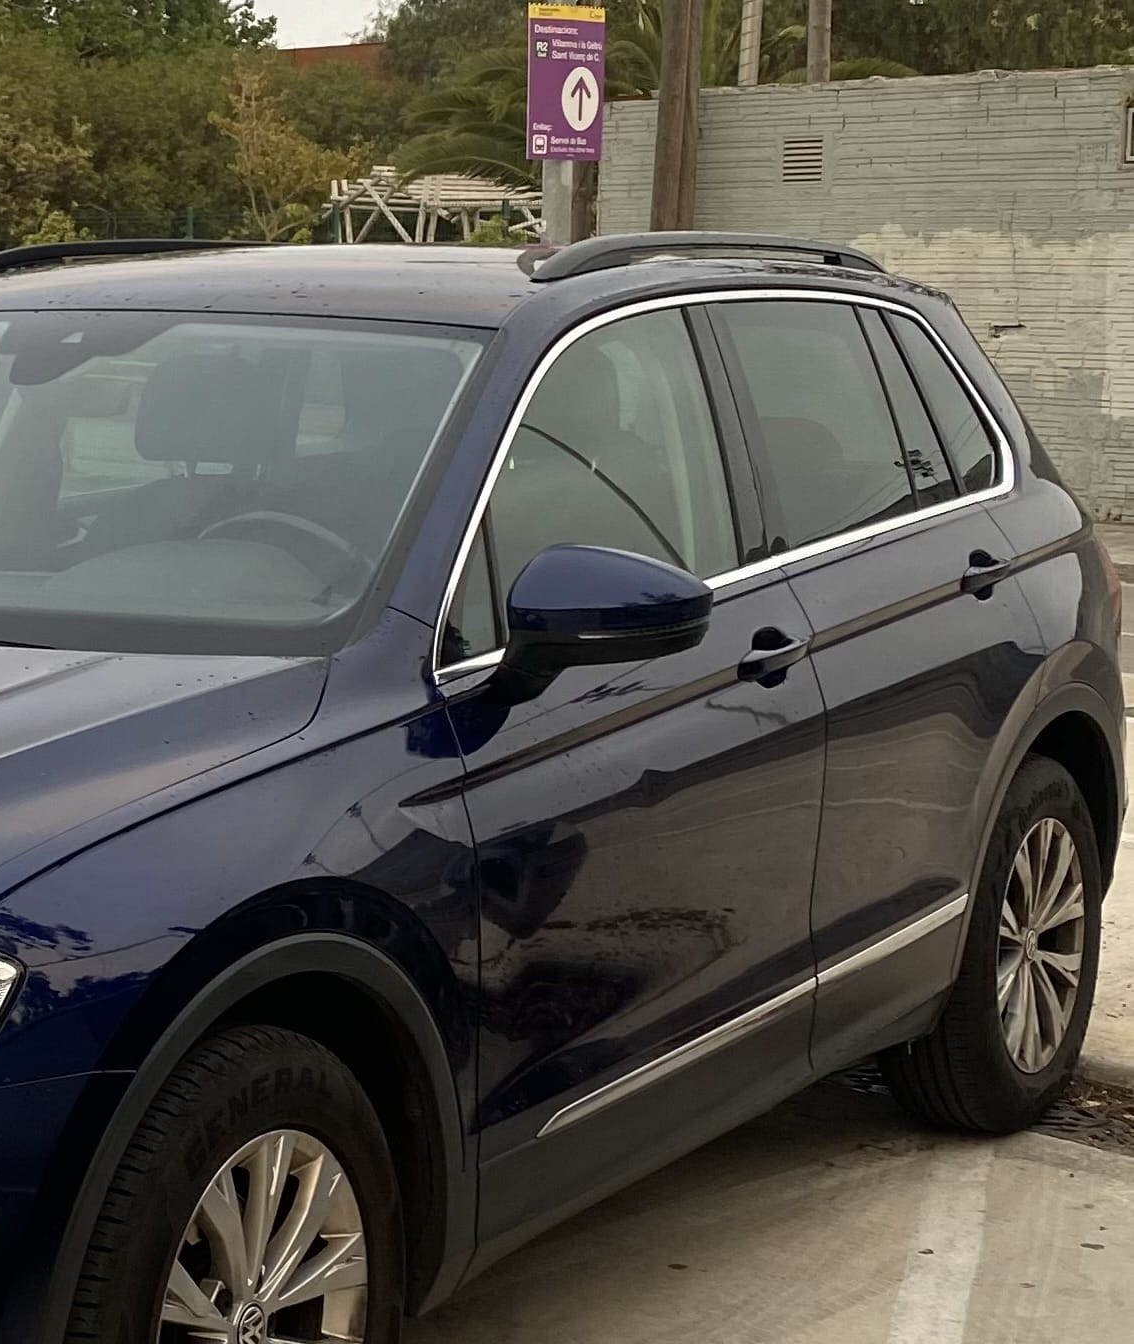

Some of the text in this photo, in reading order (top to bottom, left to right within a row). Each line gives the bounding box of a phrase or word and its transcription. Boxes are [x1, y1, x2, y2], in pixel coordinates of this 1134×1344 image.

[536, 41, 548, 51] R2
[552, 50, 567, 59] Sant
[186, 1067, 334, 1181] GENERAL
